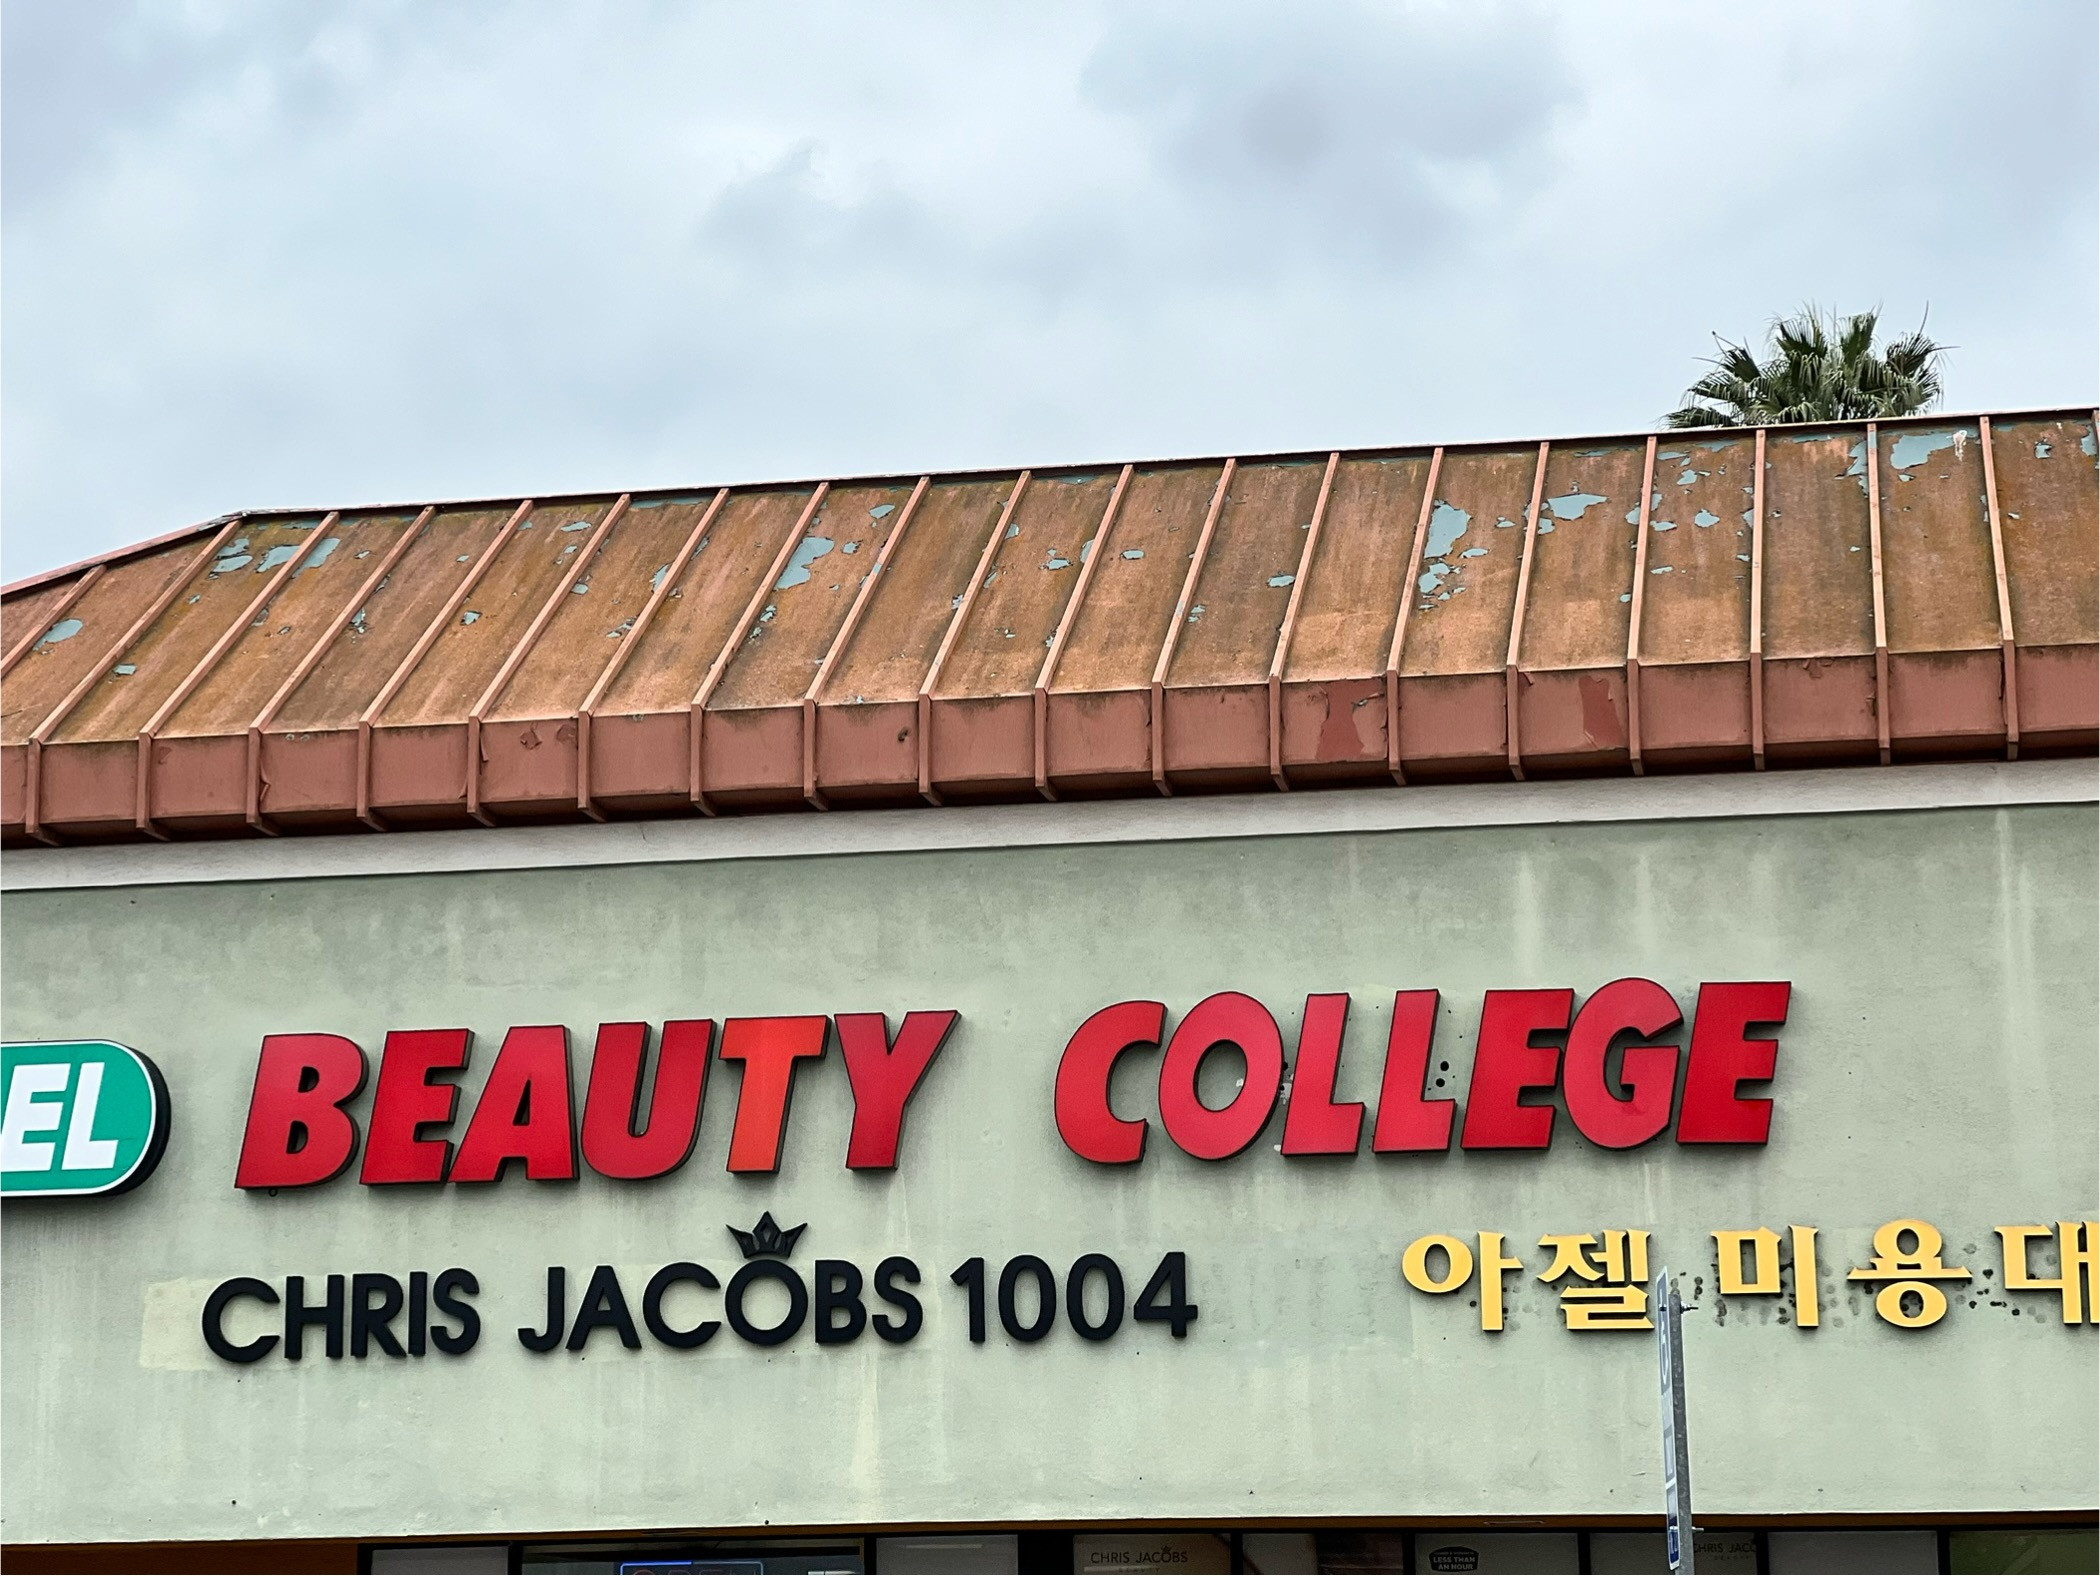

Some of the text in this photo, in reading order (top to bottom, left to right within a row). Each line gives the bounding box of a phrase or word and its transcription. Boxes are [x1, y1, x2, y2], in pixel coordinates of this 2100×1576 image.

[0, 1062, 118, 1171] EL
[235, 978, 1792, 1188] BEAUTY COLLEGE
[201, 1251, 1199, 1367] CHRIS JACOBS 1004
[1402, 1228, 1654, 1332] 아젤
[1714, 1219, 2099, 1328] 미용대
[1090, 1551, 1188, 1564] CHRIS JACOBS
